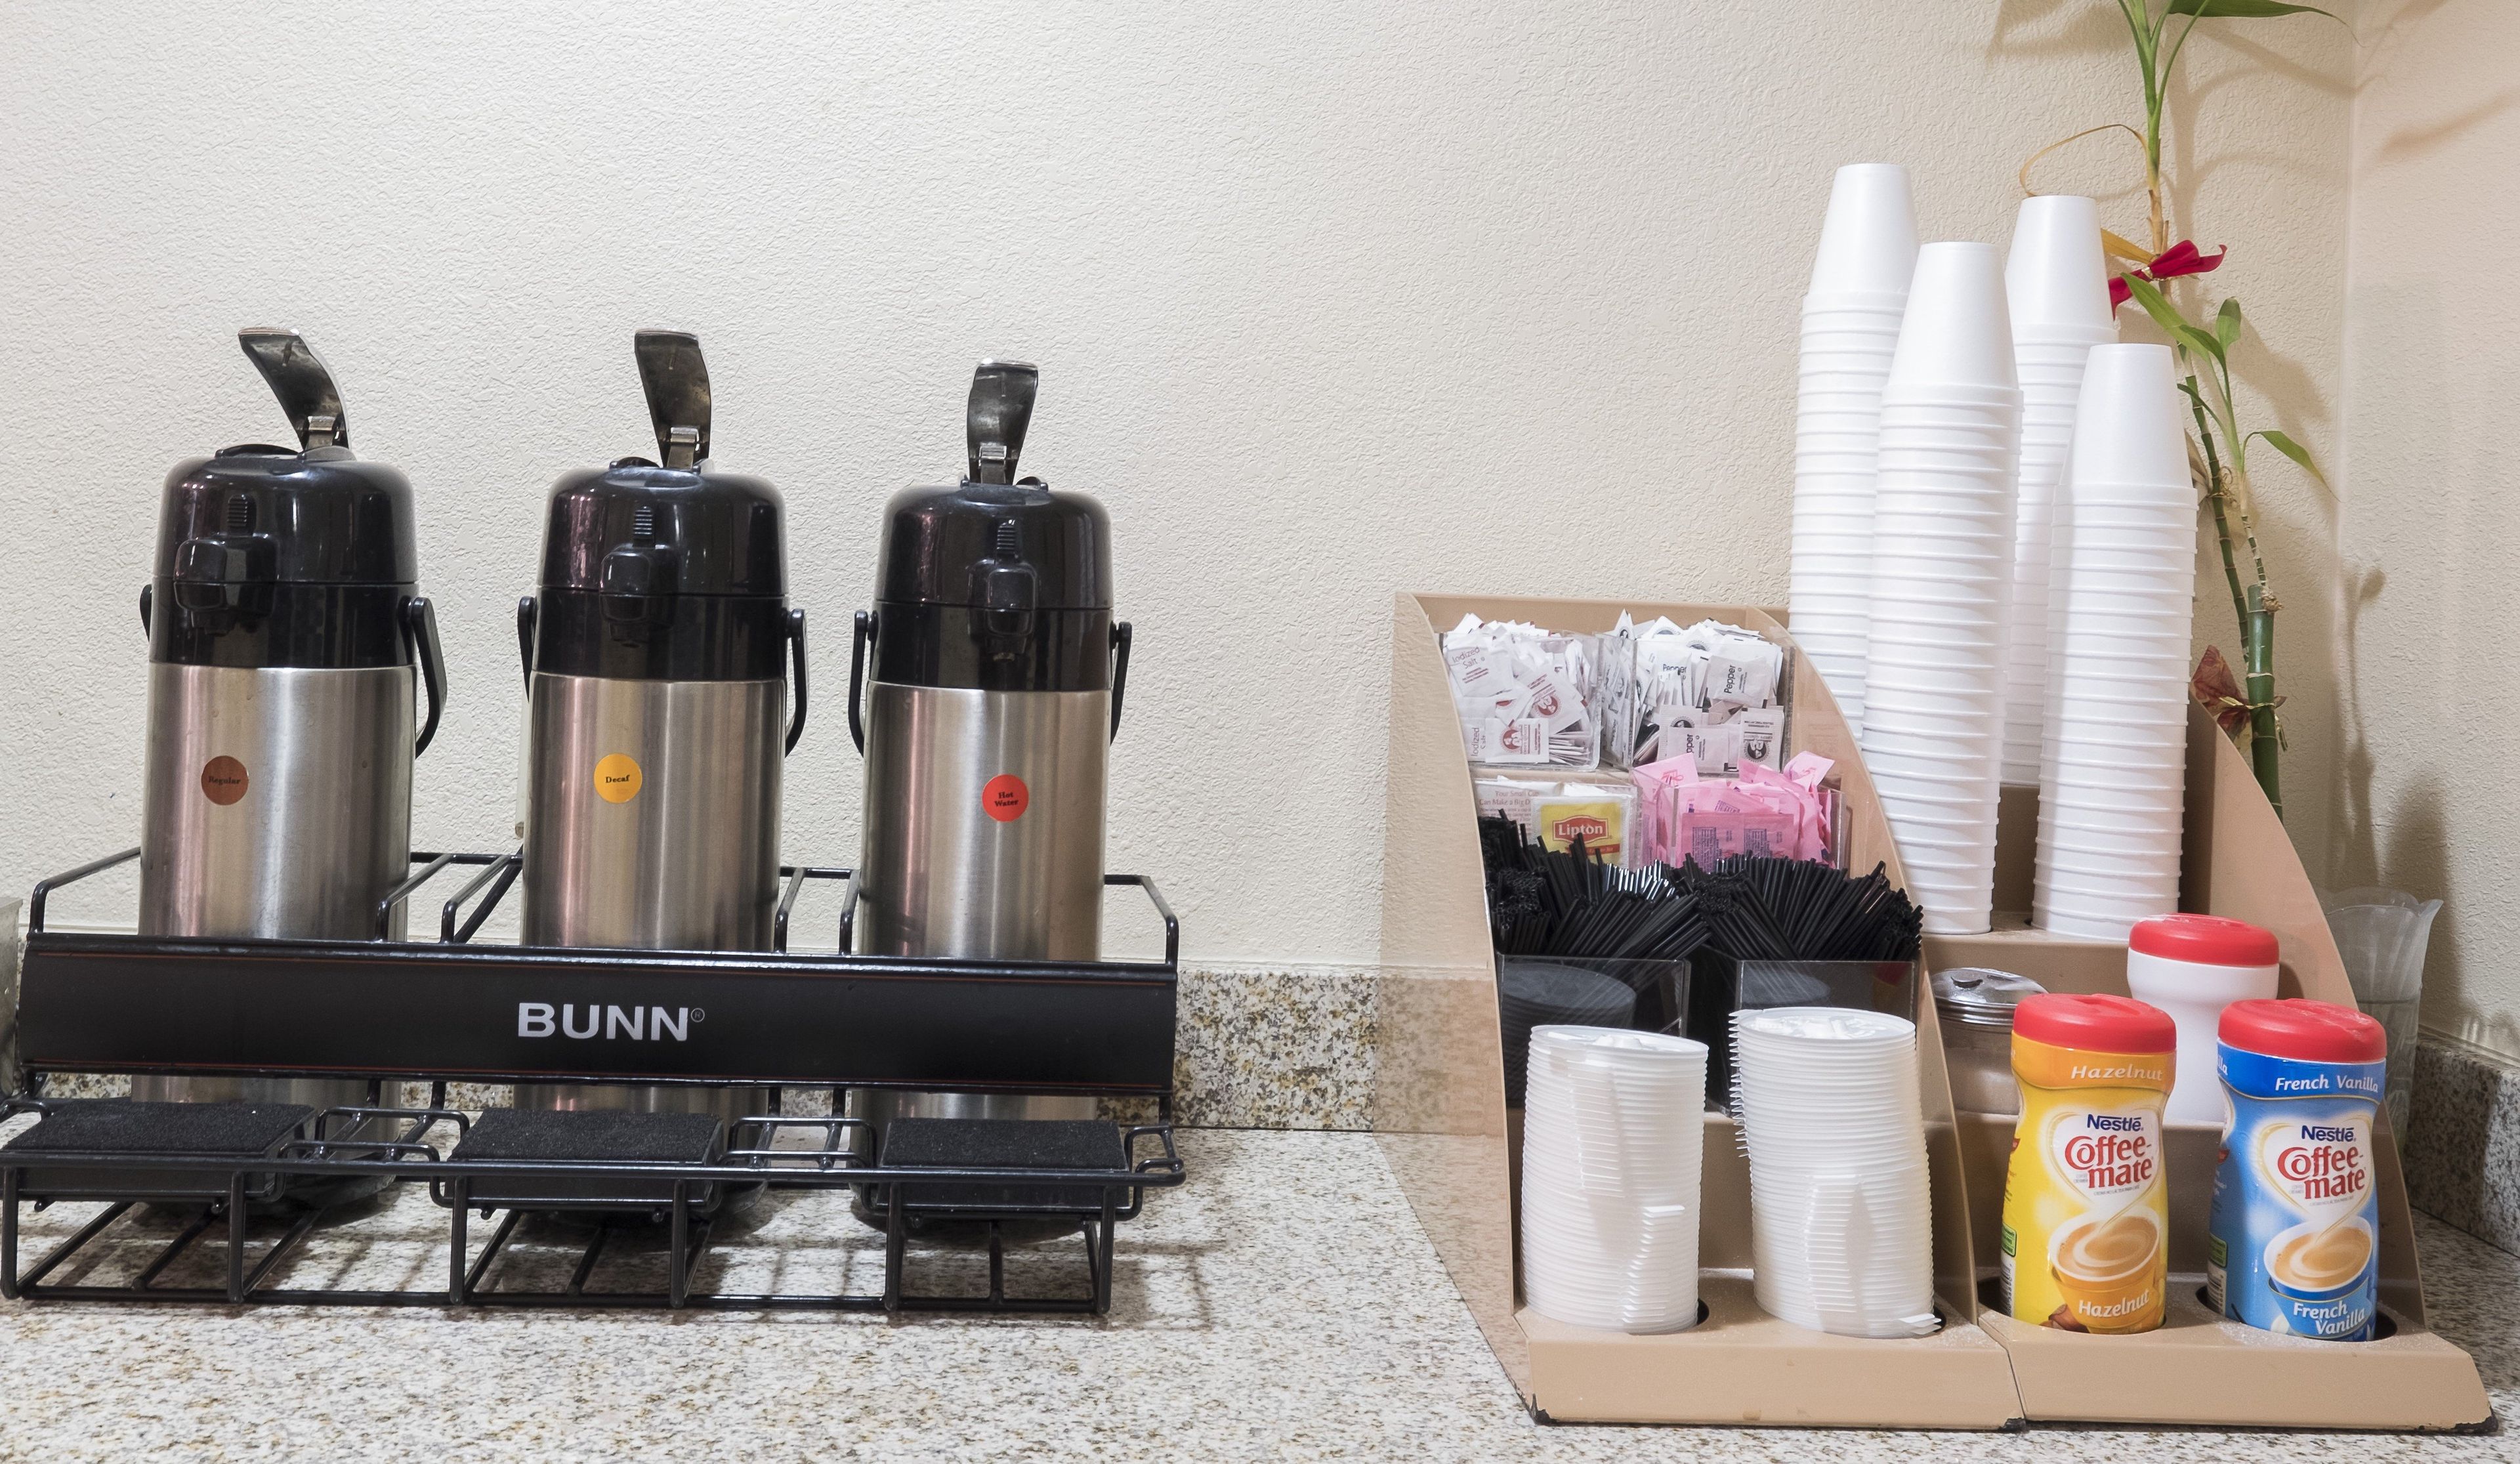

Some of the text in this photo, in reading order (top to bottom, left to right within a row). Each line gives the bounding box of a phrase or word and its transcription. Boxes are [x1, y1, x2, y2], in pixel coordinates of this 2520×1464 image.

[1724, 665, 1736, 694] Pepper
[1471, 727, 1480, 757] Iodized
[208, 776, 241, 785] Regular
[605, 774, 630, 784] Decaf
[1559, 824, 1603, 838] Lipton
[518, 1003, 688, 1041] BUNN
[2071, 1063, 2163, 1081] Hazelnut
[2275, 1074, 2378, 1093] French Vanilla
[2088, 1159, 2152, 1188] mate
[2304, 1169, 2365, 1200] mate
[2078, 1288, 2149, 1318] Hazelnut
[2293, 1300, 2348, 1320] French
[2315, 1308, 2365, 1335] Vanilla
